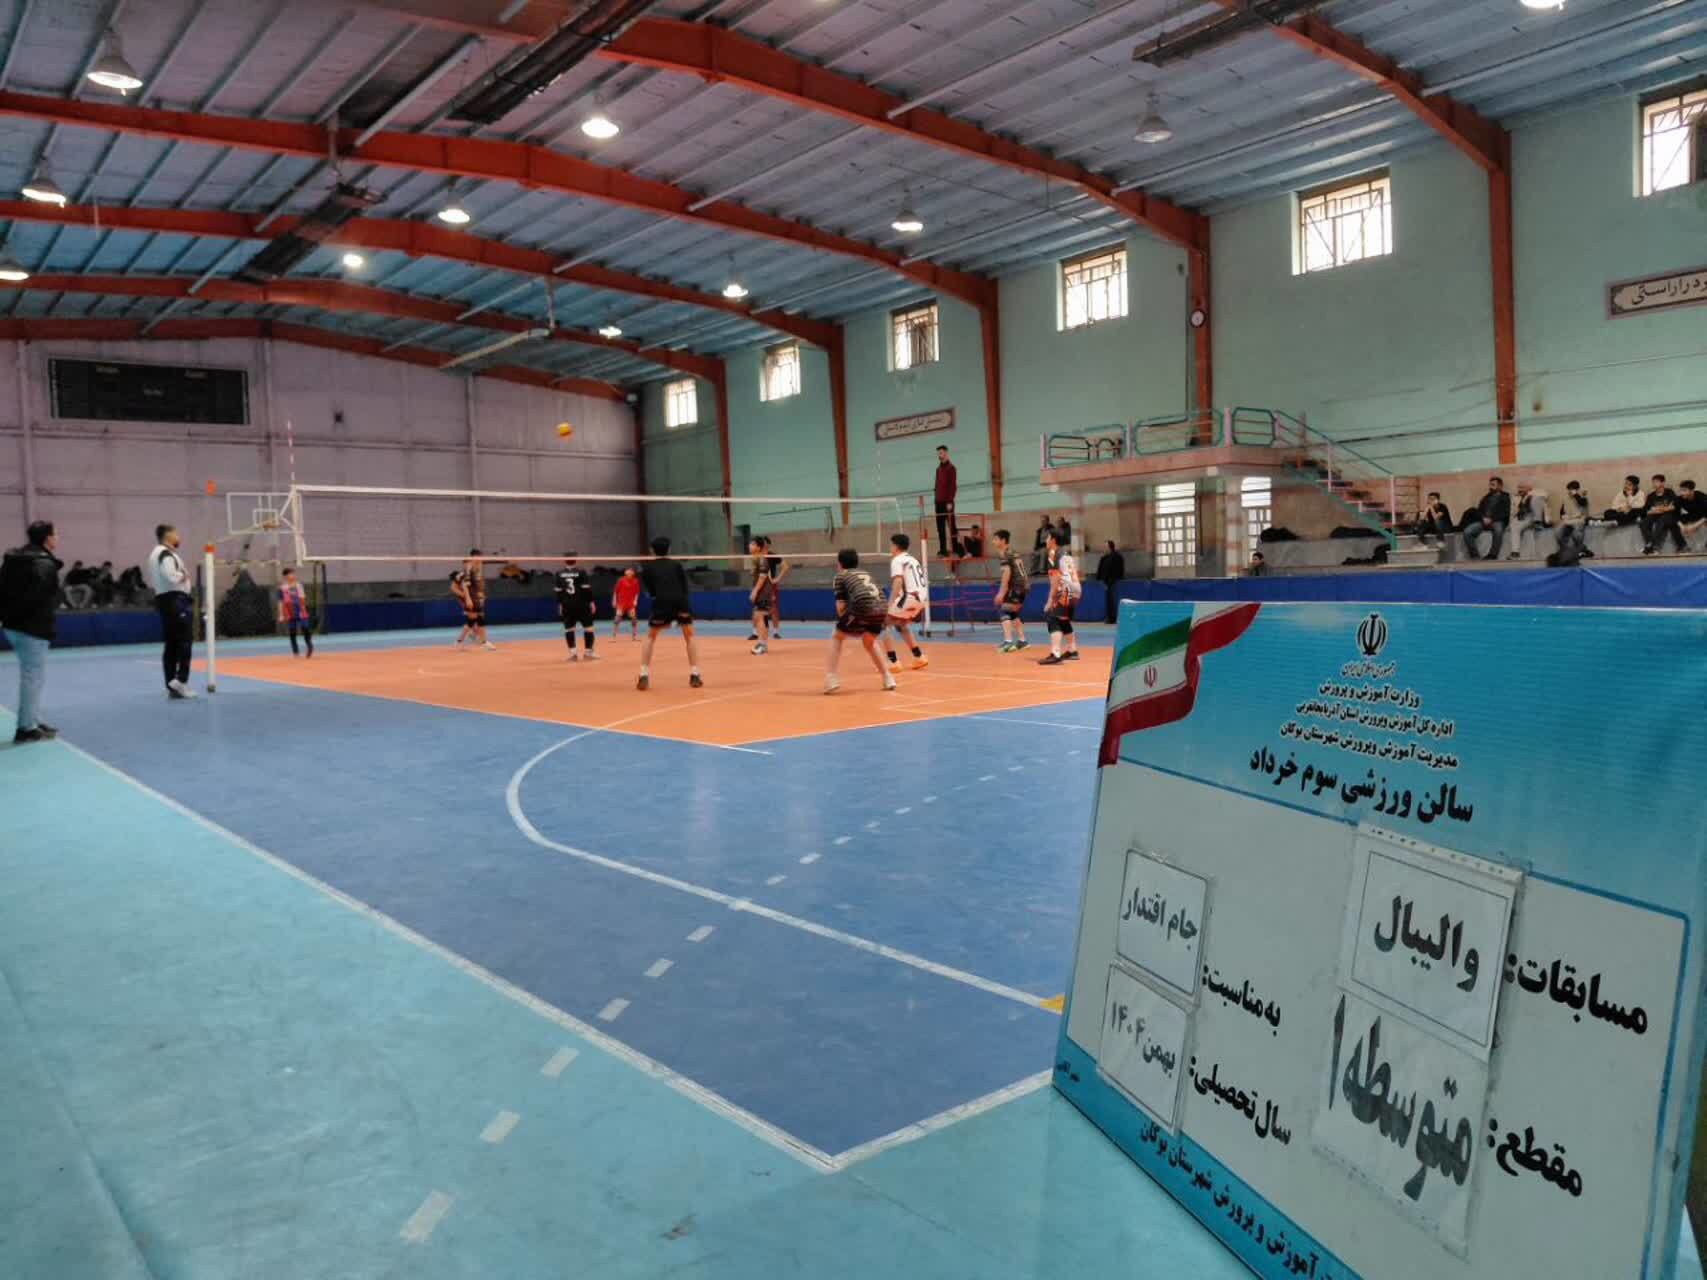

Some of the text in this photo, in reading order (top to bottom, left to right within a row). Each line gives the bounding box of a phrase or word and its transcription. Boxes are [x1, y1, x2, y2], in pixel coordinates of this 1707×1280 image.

[565, 578, 576, 595] 3
[858, 574, 879, 597] 3
[1320, 682, 1420, 708] وزارت آموزش و پرورش
[1340, 706, 1359, 721] استان
[1389, 715, 1417, 730] آموزش
[1280, 721, 1302, 737] بوکان
[1304, 726, 1339, 744] شهرستان
[1417, 719, 1431, 734] کل
[1431, 722, 1453, 736] اداره
[1380, 741, 1415, 760] آموزش
[1417, 750, 1458, 768] مدیریت
[1250, 747, 1473, 823] سالن ورزشی سوم خرداد
[1123, 887, 1197, 950] جام اقتدار
[1374, 895, 1479, 992] والیبال
[1503, 953, 1648, 1035] مسابقات:
[1144, 1037, 1175, 1079] بهمن
[1189, 1055, 1291, 1145] سال تحصیلی:
[1343, 1015, 1472, 1201] متوسطه
[1487, 1118, 1583, 1197] مقطع:
[1140, 1121, 1319, 1280] آموزش و پرورش شهرستان بوکان
